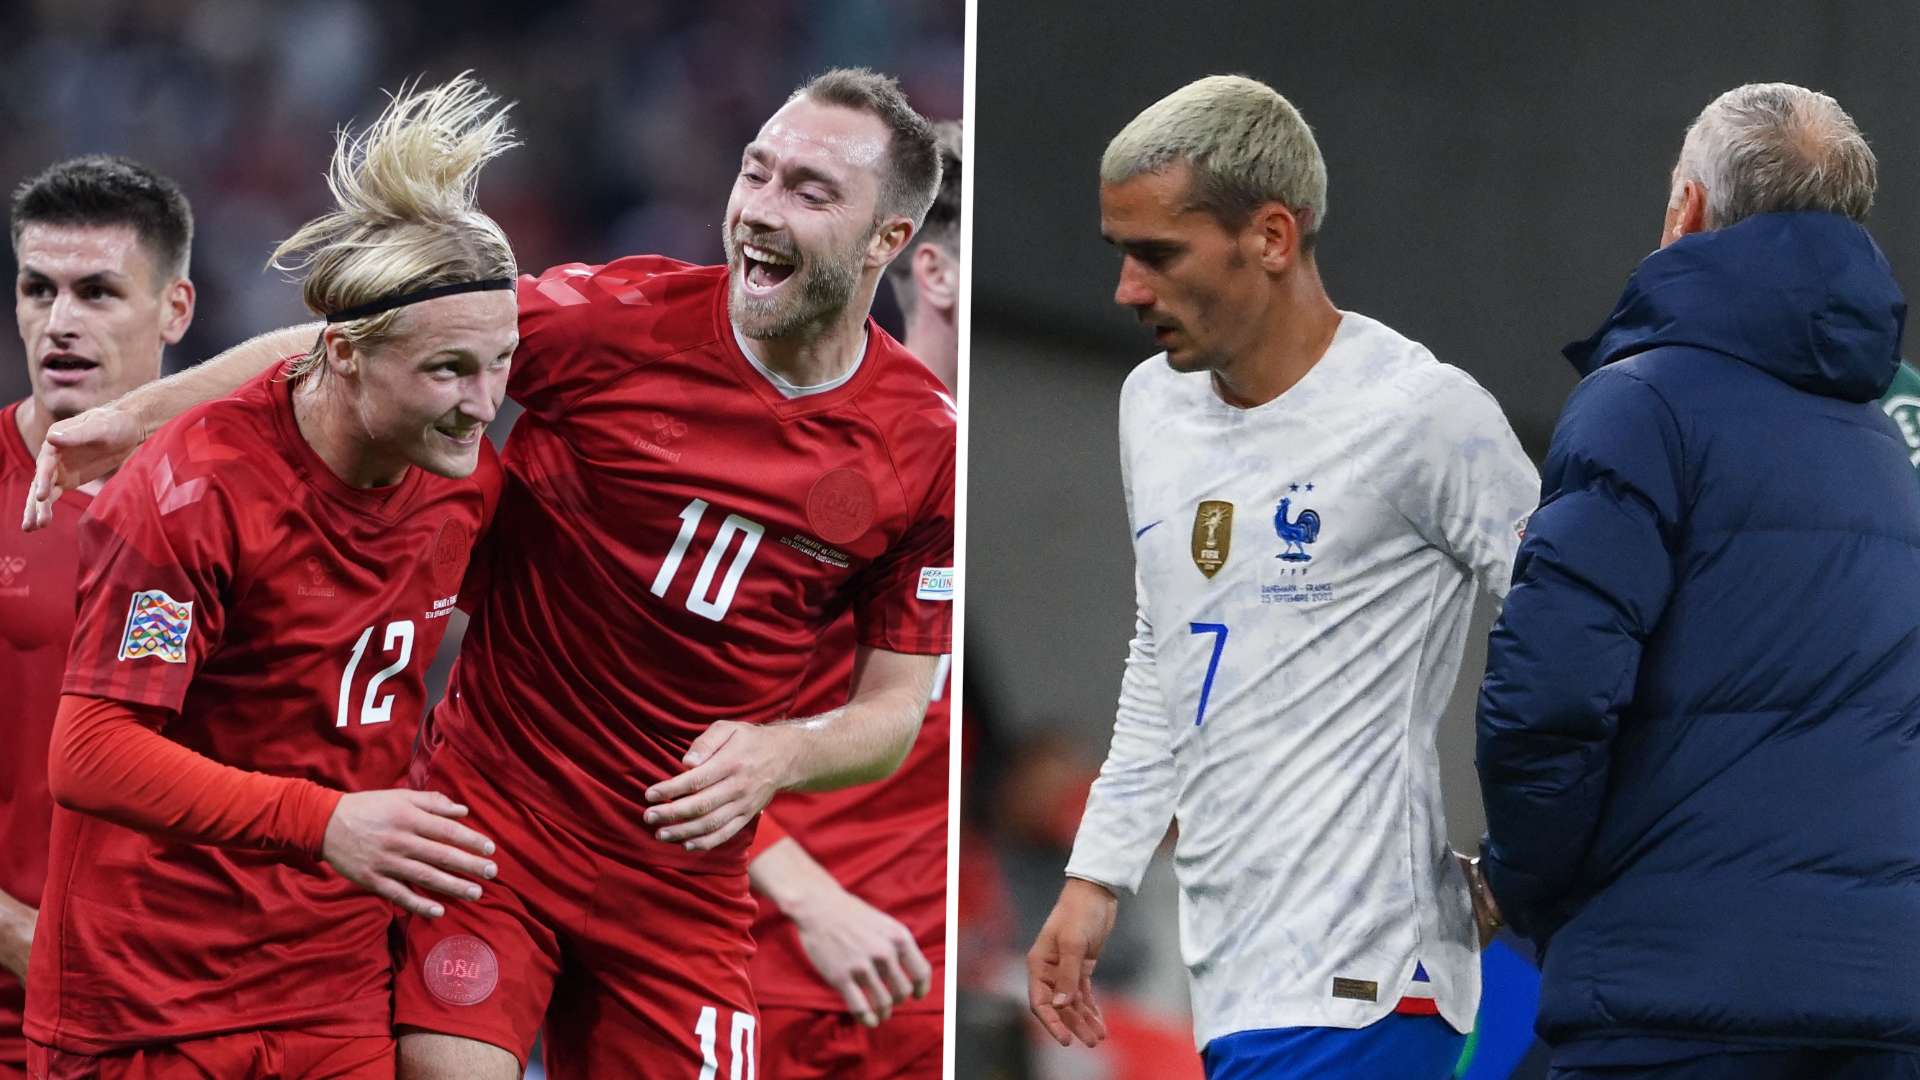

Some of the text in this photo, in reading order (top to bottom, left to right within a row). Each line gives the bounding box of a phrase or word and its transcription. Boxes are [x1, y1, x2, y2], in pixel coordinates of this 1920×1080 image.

[650, 498, 765, 622] 10
[336, 620, 414, 727] 12
[1189, 622, 1228, 726] 7
[695, 1006, 755, 1080] 10
